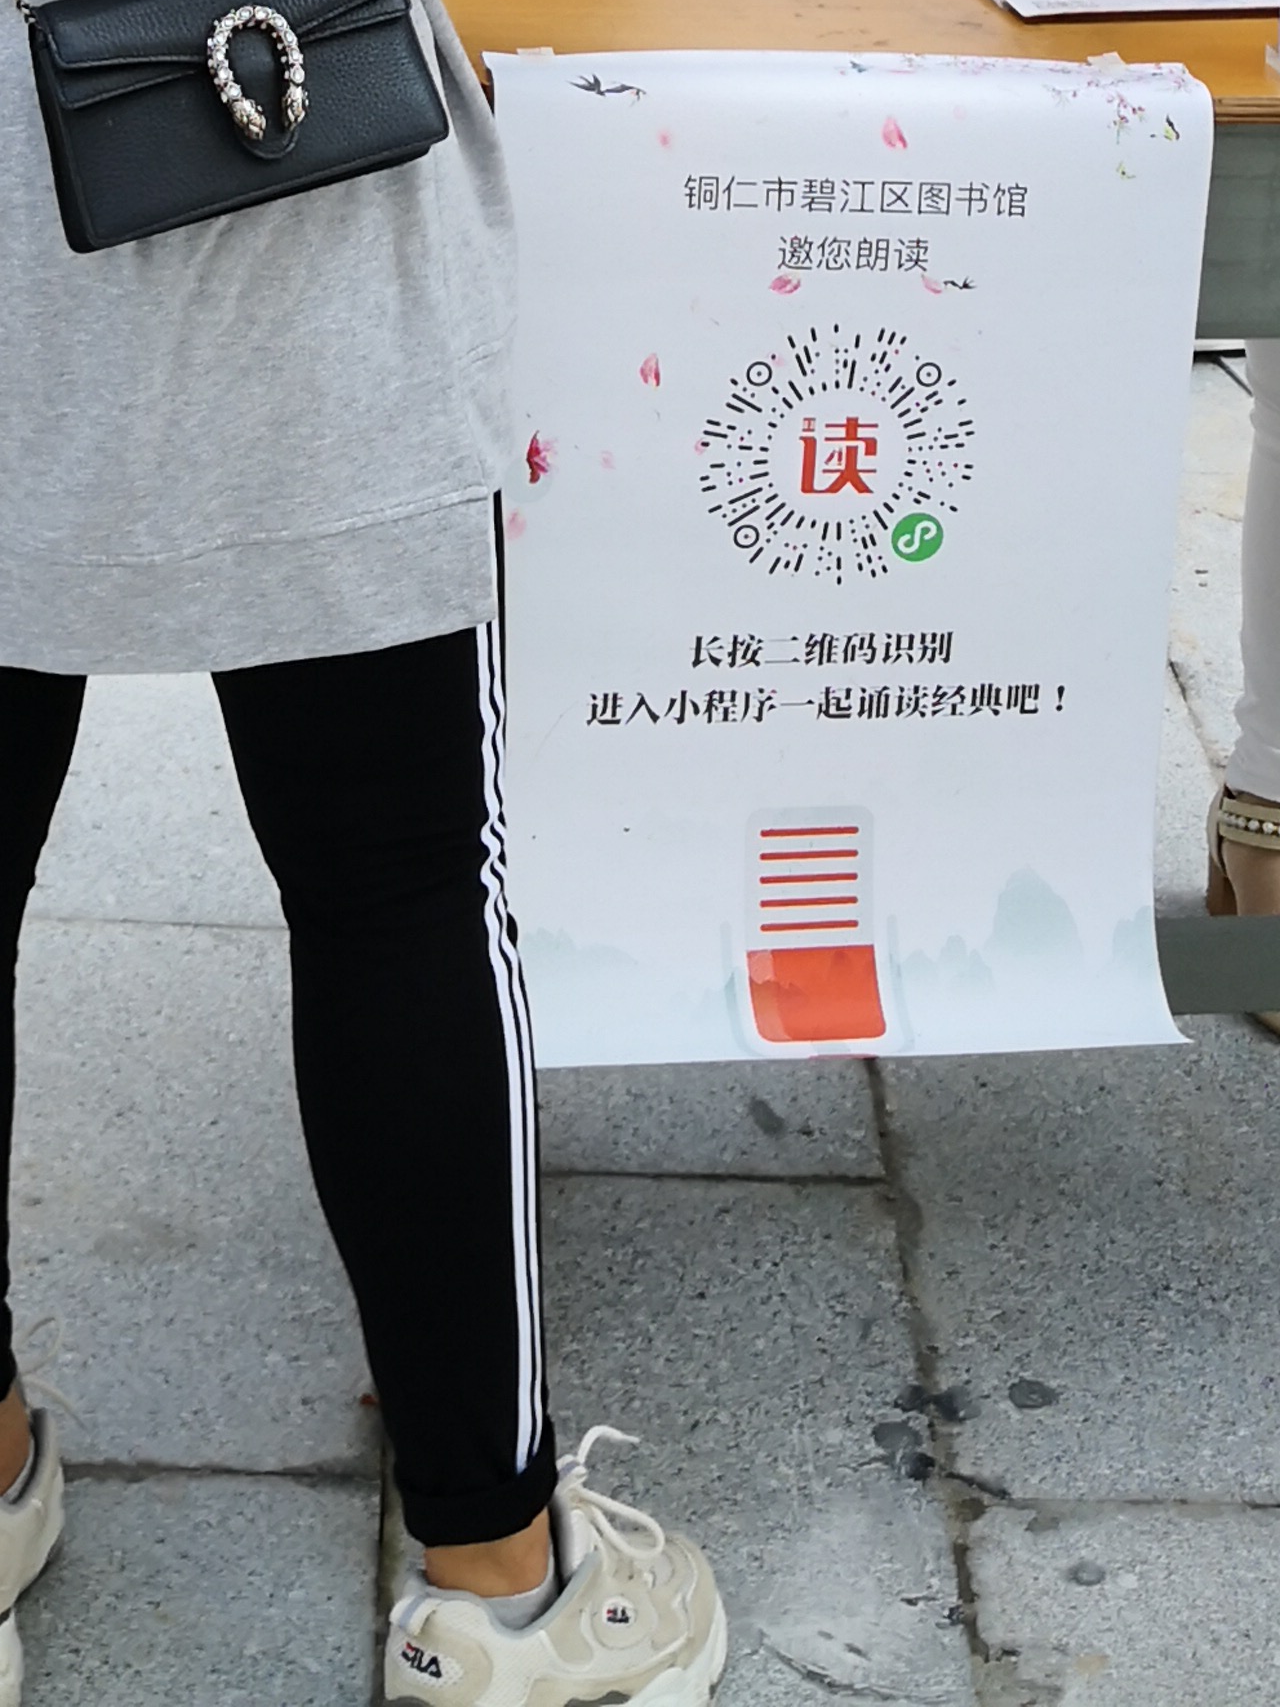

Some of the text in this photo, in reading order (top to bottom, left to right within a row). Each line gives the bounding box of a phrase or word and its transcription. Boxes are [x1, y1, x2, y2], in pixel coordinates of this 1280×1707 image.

[683, 173, 1028, 220] 铜仁市碧江区图书馆
[777, 236, 931, 274] 邀您朗读
[688, 631, 954, 672] 长按二维码识别
[586, 683, 1068, 729] 进入小程序一起诵读经典吧！
[401, 1642, 442, 1679] FILA
